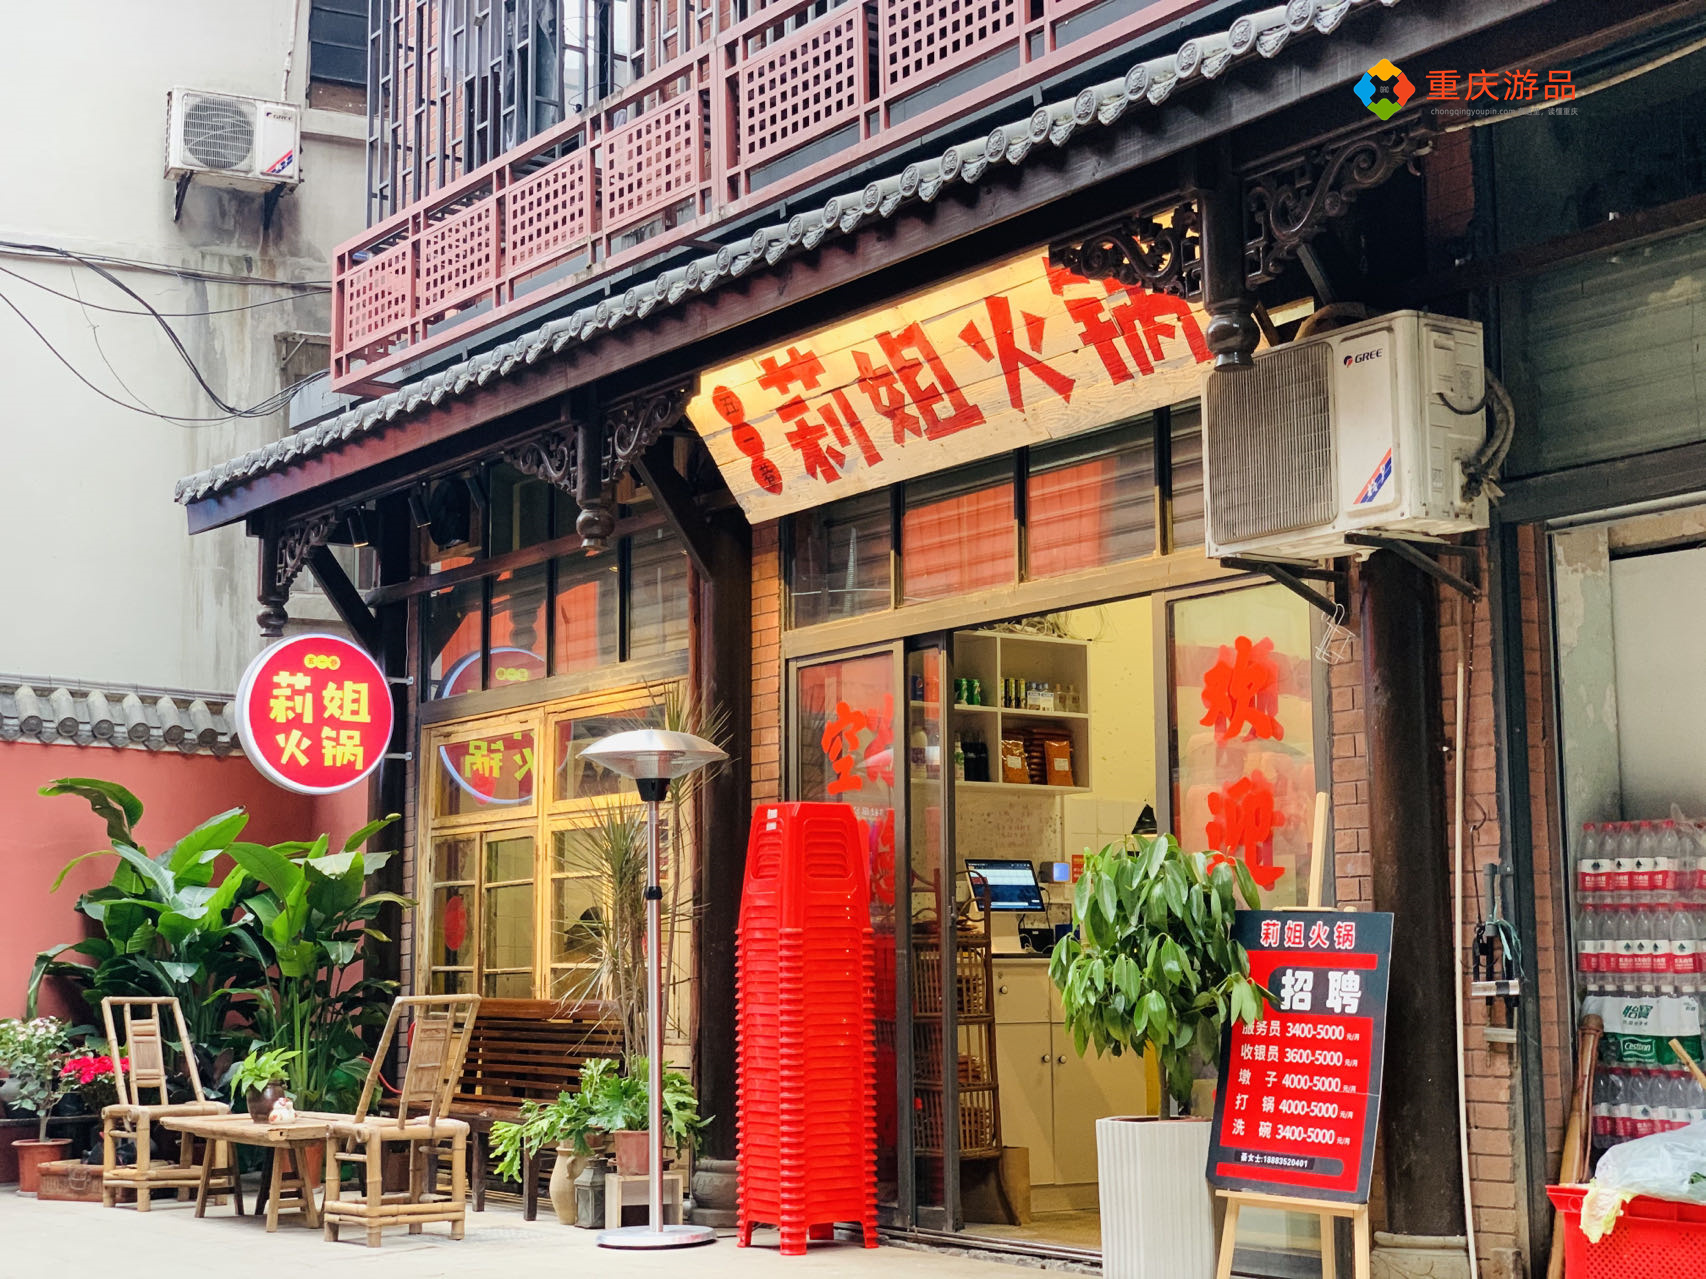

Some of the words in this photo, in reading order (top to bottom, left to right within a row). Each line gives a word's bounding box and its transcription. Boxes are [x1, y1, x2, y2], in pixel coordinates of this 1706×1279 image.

[1354, 348, 1384, 364] GREE
[757, 256, 1215, 484] 莉姐火锅
[269, 671, 371, 724] 莉姐
[275, 726, 364, 770] 火锅
[1260, 920, 1356, 950] 莉姐火锅
[1280, 968, 1362, 1014] 招聘
[1285, 1022, 1345, 1040] 3400-5000
[1240, 1043, 1279, 1062] 收银员
[1284, 1048, 1343, 1066] 3600-5000
[1281, 1073, 1341, 1092] 4000-5000
[1278, 1099, 1338, 1118] 4000-5000
[1275, 1124, 1335, 1144] 3400-5000
